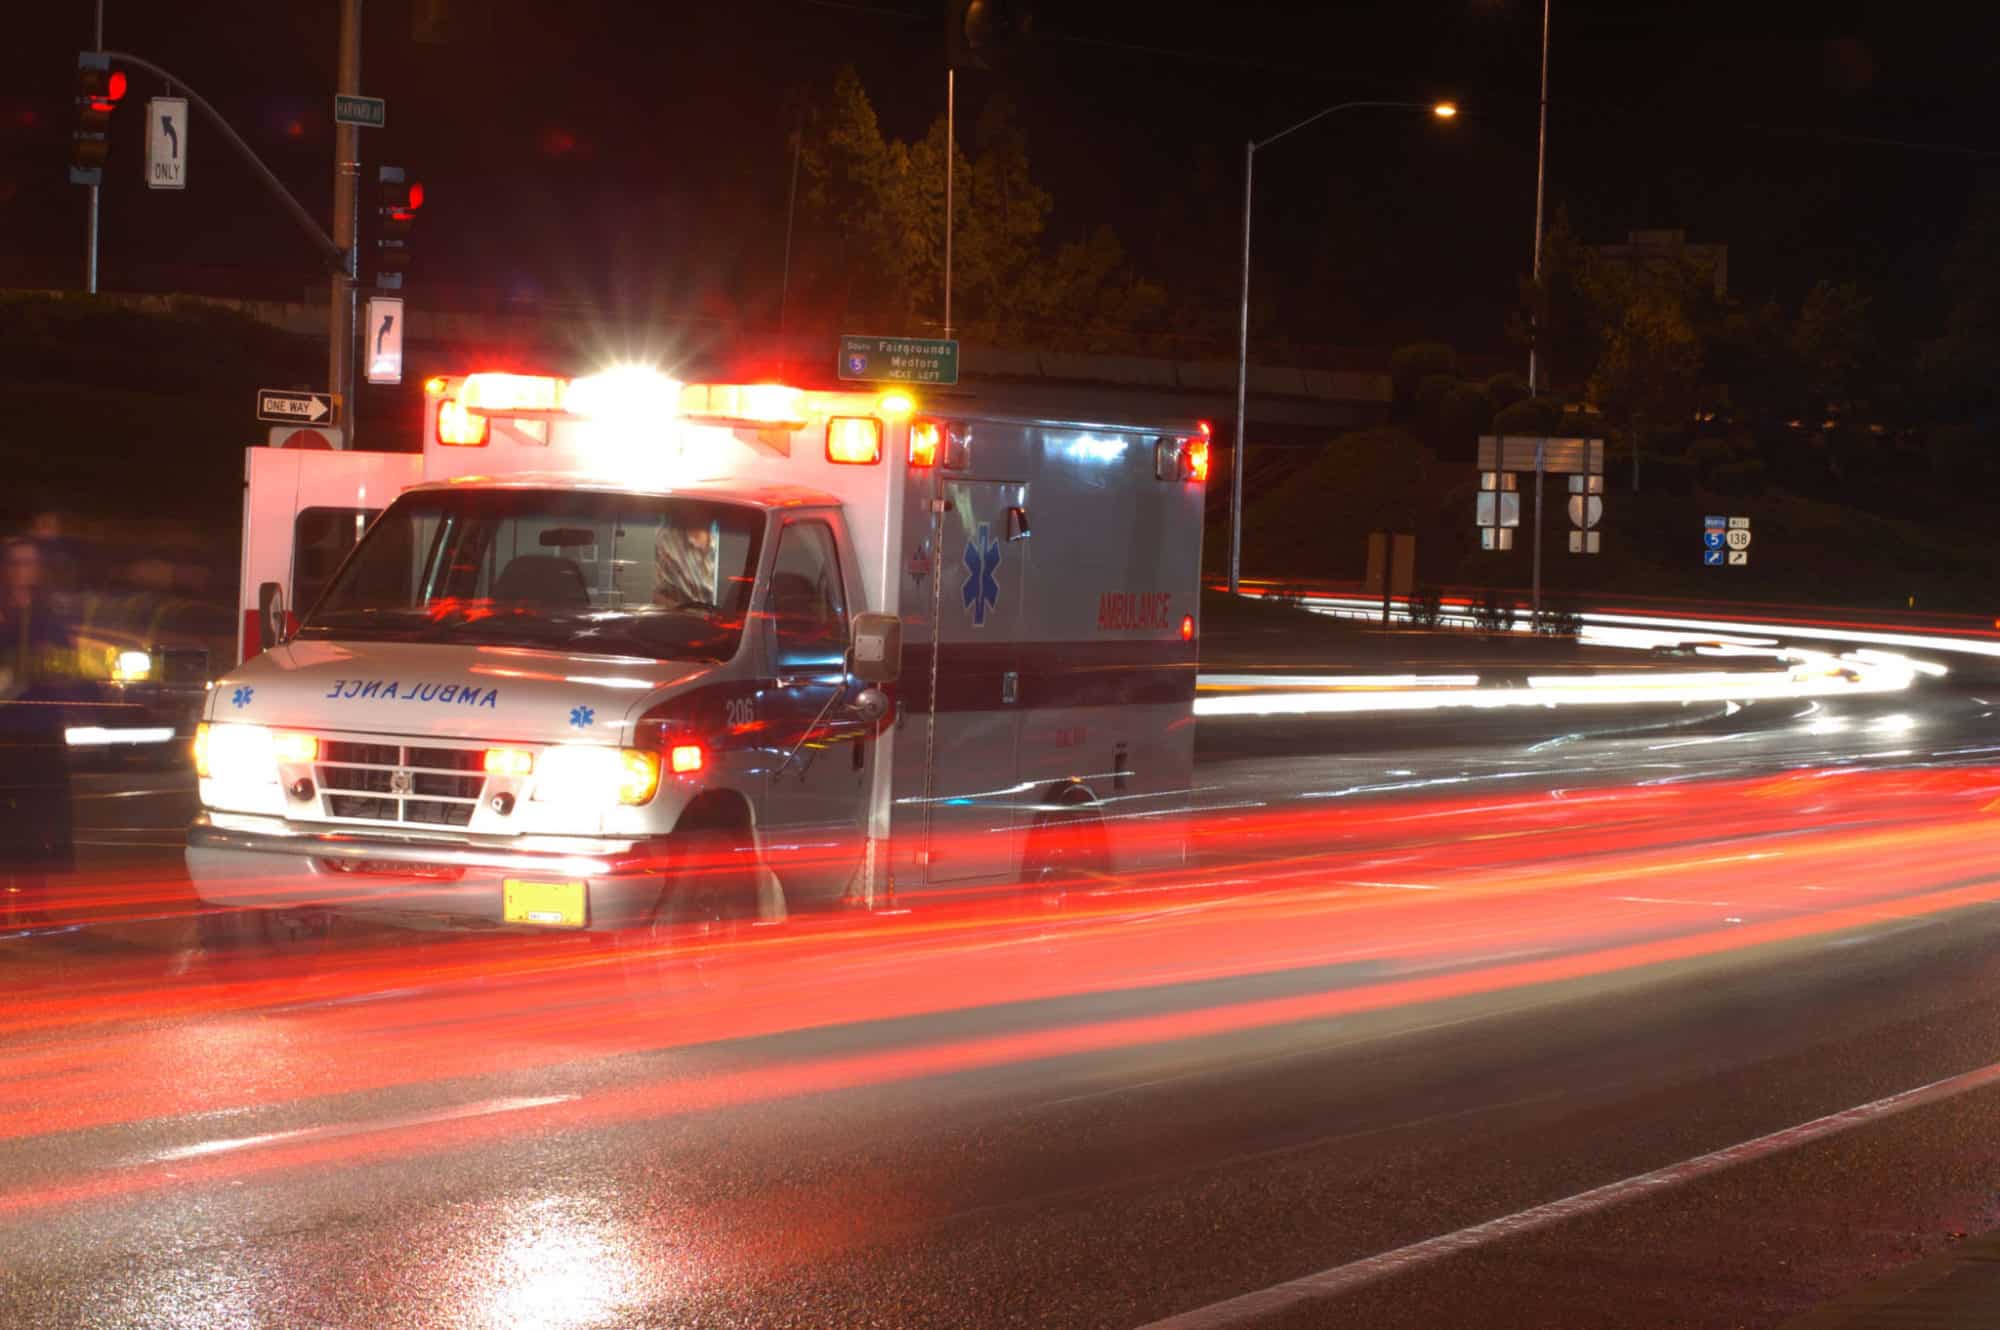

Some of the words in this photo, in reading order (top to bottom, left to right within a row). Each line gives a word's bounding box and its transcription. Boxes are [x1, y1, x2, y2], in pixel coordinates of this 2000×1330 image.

[153, 163, 181, 181] ONLY
[879, 341, 952, 355] Fairgrounds
[891, 356, 939, 369] Medford
[266, 398, 287, 412] ONE
[289, 400, 310, 414] WAY
[1730, 533, 1747, 545] 138
[1098, 592, 1170, 629] AMBULANCE
[726, 698, 754, 727] 206
